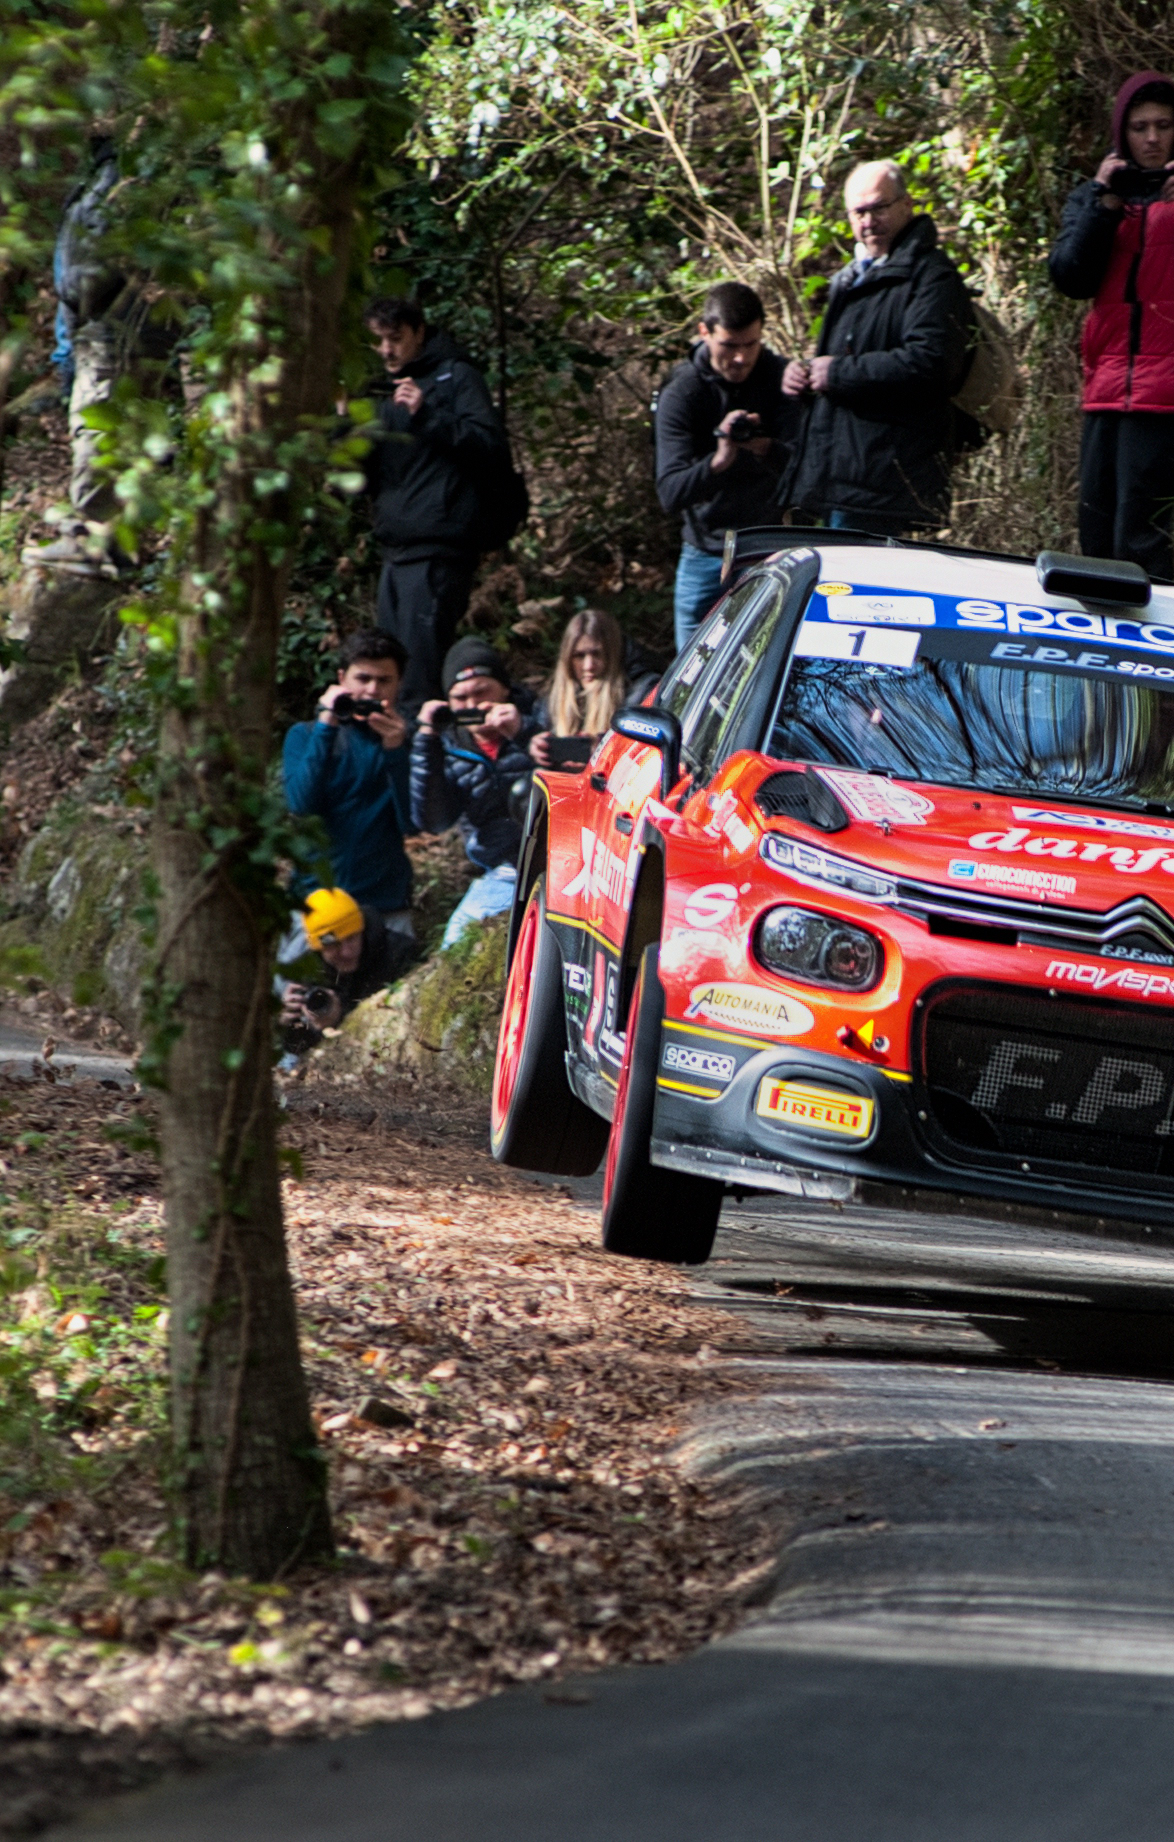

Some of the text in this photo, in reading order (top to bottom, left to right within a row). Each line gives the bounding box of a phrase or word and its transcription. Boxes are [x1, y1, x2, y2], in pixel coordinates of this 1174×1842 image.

[848, 629, 867, 657] 1
[690, 988, 790, 1022] AUTOMANIA
[666, 1046, 732, 1078] sparco
[769, 1087, 862, 1128] PIRELLI
